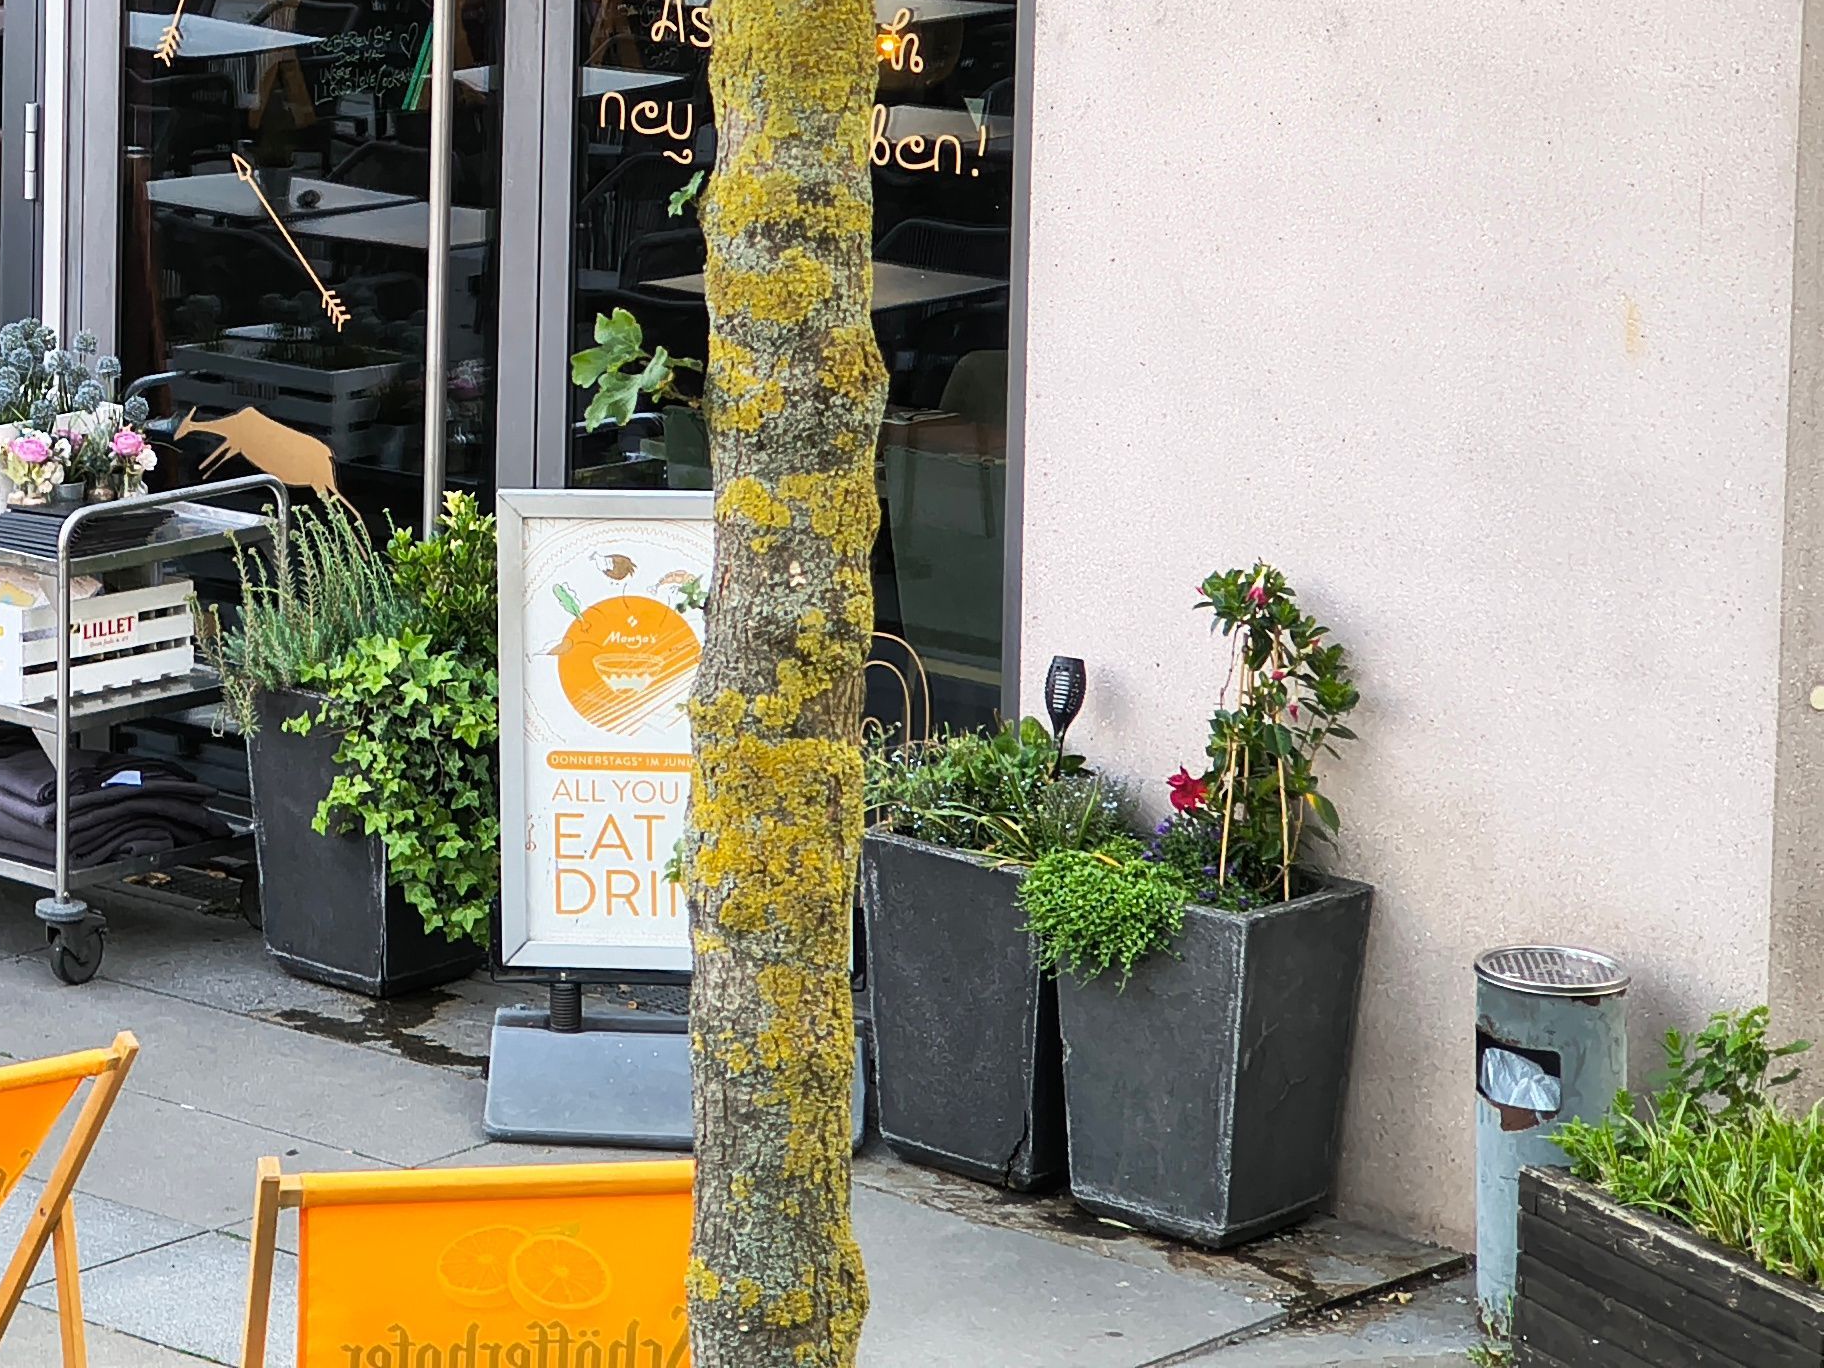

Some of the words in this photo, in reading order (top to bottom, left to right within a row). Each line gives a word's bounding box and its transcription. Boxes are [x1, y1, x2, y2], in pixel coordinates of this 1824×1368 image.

[83, 615, 136, 640] LILLET
[602, 631, 657, 649] Mongo's
[646, 756, 660, 768] IM
[551, 778, 606, 803] ALL
[612, 779, 679, 805] YOU
[554, 812, 666, 862] EAT
[555, 868, 687, 918] DRI
